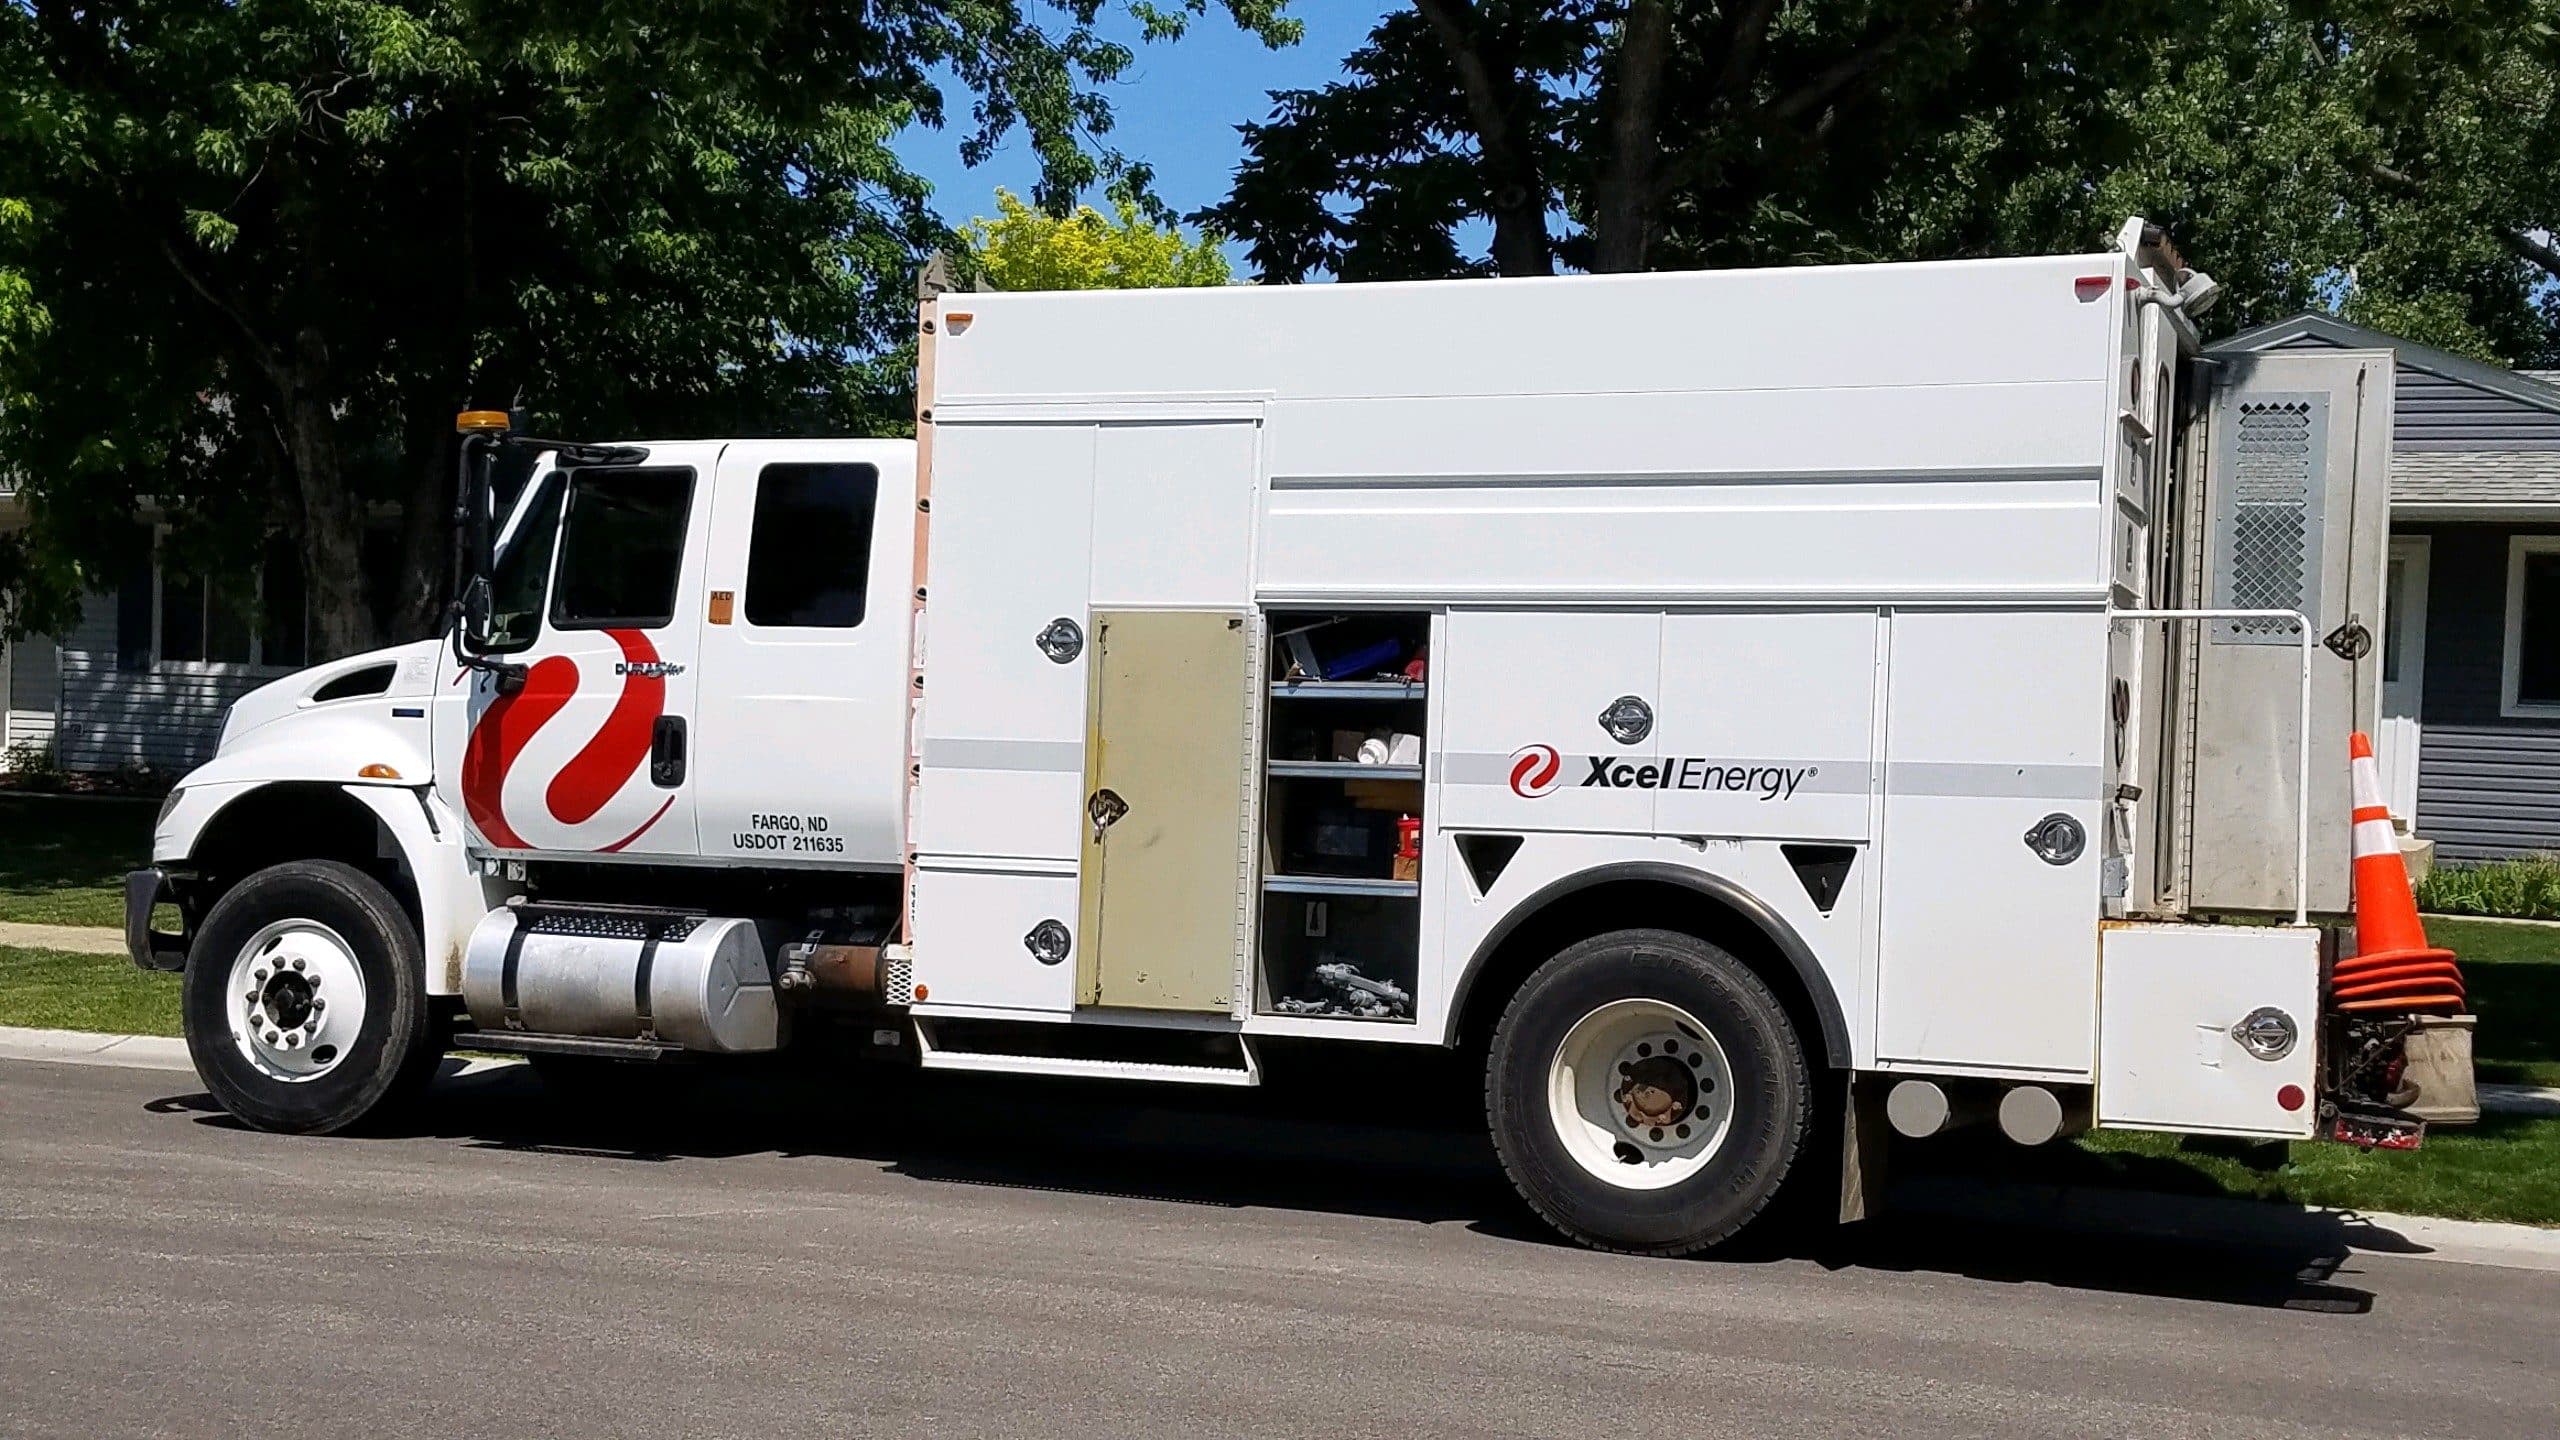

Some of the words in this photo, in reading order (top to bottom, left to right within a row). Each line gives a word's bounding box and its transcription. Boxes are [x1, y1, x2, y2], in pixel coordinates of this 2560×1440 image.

[712, 591, 732, 601] AED
[1580, 756, 1675, 789] Xcel
[752, 814, 804, 834] FARGO,
[807, 816, 828, 832] ND
[733, 833, 787, 850] USDOT
[792, 836, 844, 852] 211635
